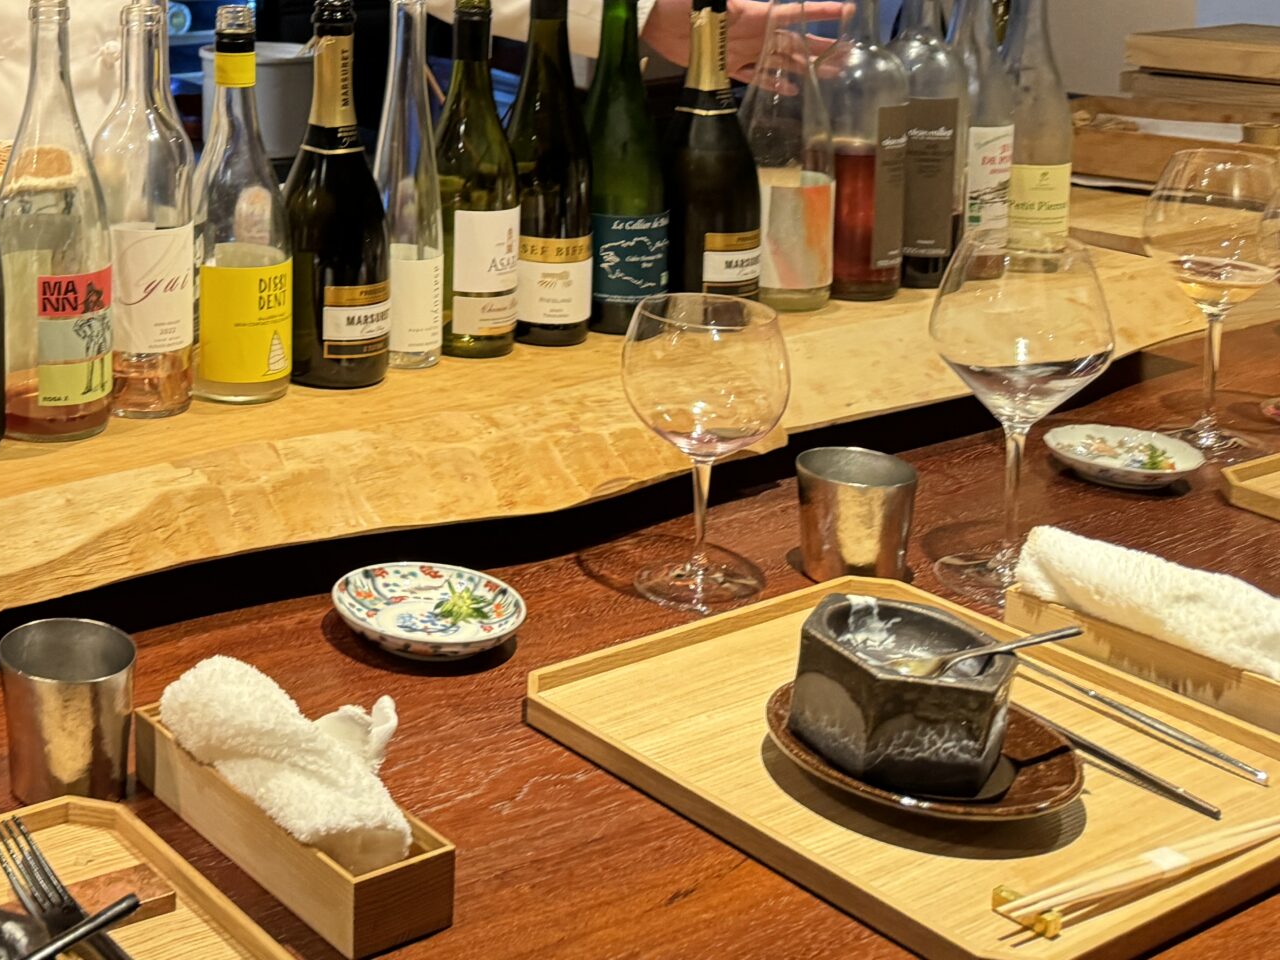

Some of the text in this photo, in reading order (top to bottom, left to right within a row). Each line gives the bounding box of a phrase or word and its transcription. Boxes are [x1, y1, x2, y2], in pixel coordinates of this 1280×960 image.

[341, 48, 350, 107] MARSURET
[41, 280, 78, 296] MA
[41, 295, 79, 313] NN
[258, 290, 287, 311] DENT
